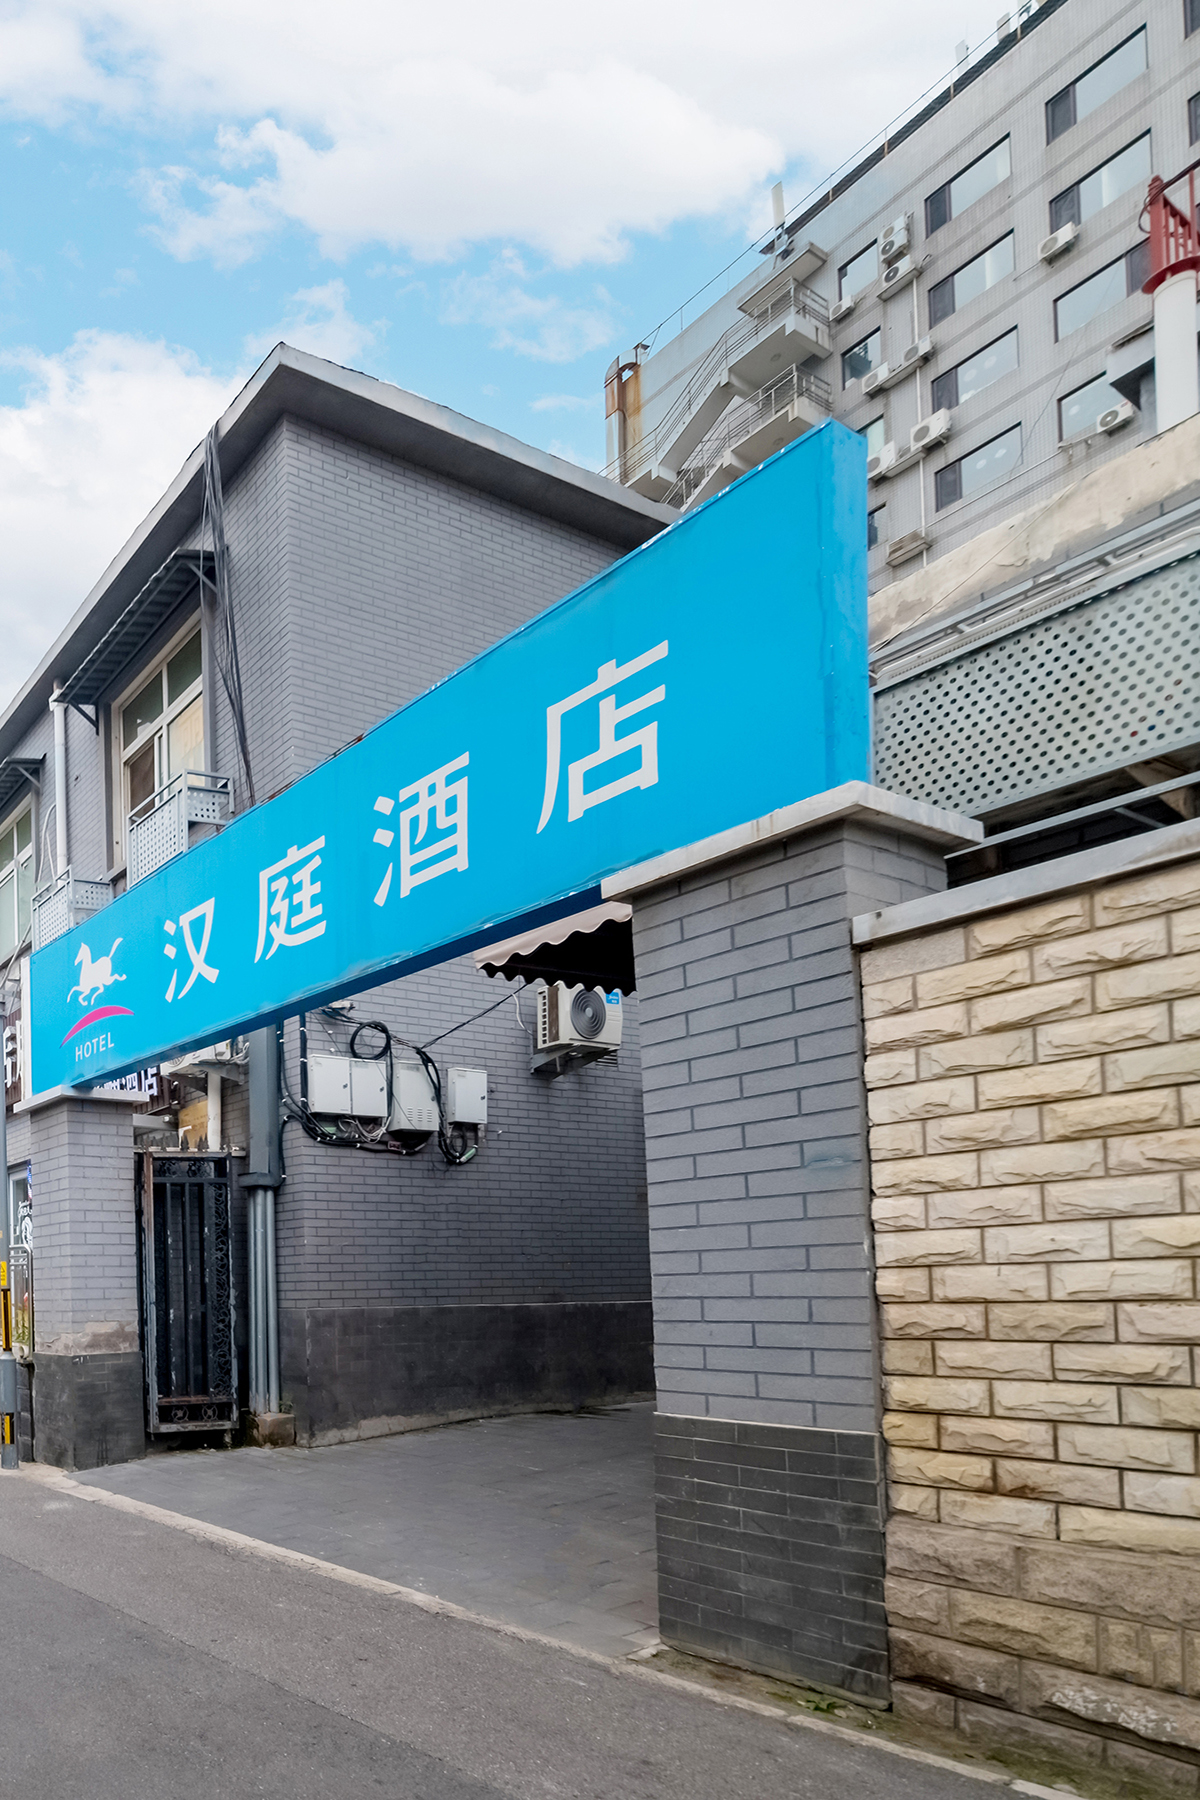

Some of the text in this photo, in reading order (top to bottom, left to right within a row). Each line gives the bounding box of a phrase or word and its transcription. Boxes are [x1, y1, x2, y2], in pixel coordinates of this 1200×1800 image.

[163, 639, 669, 1002] 汉庭酒店
[75, 1032, 115, 1062] HOTEL
